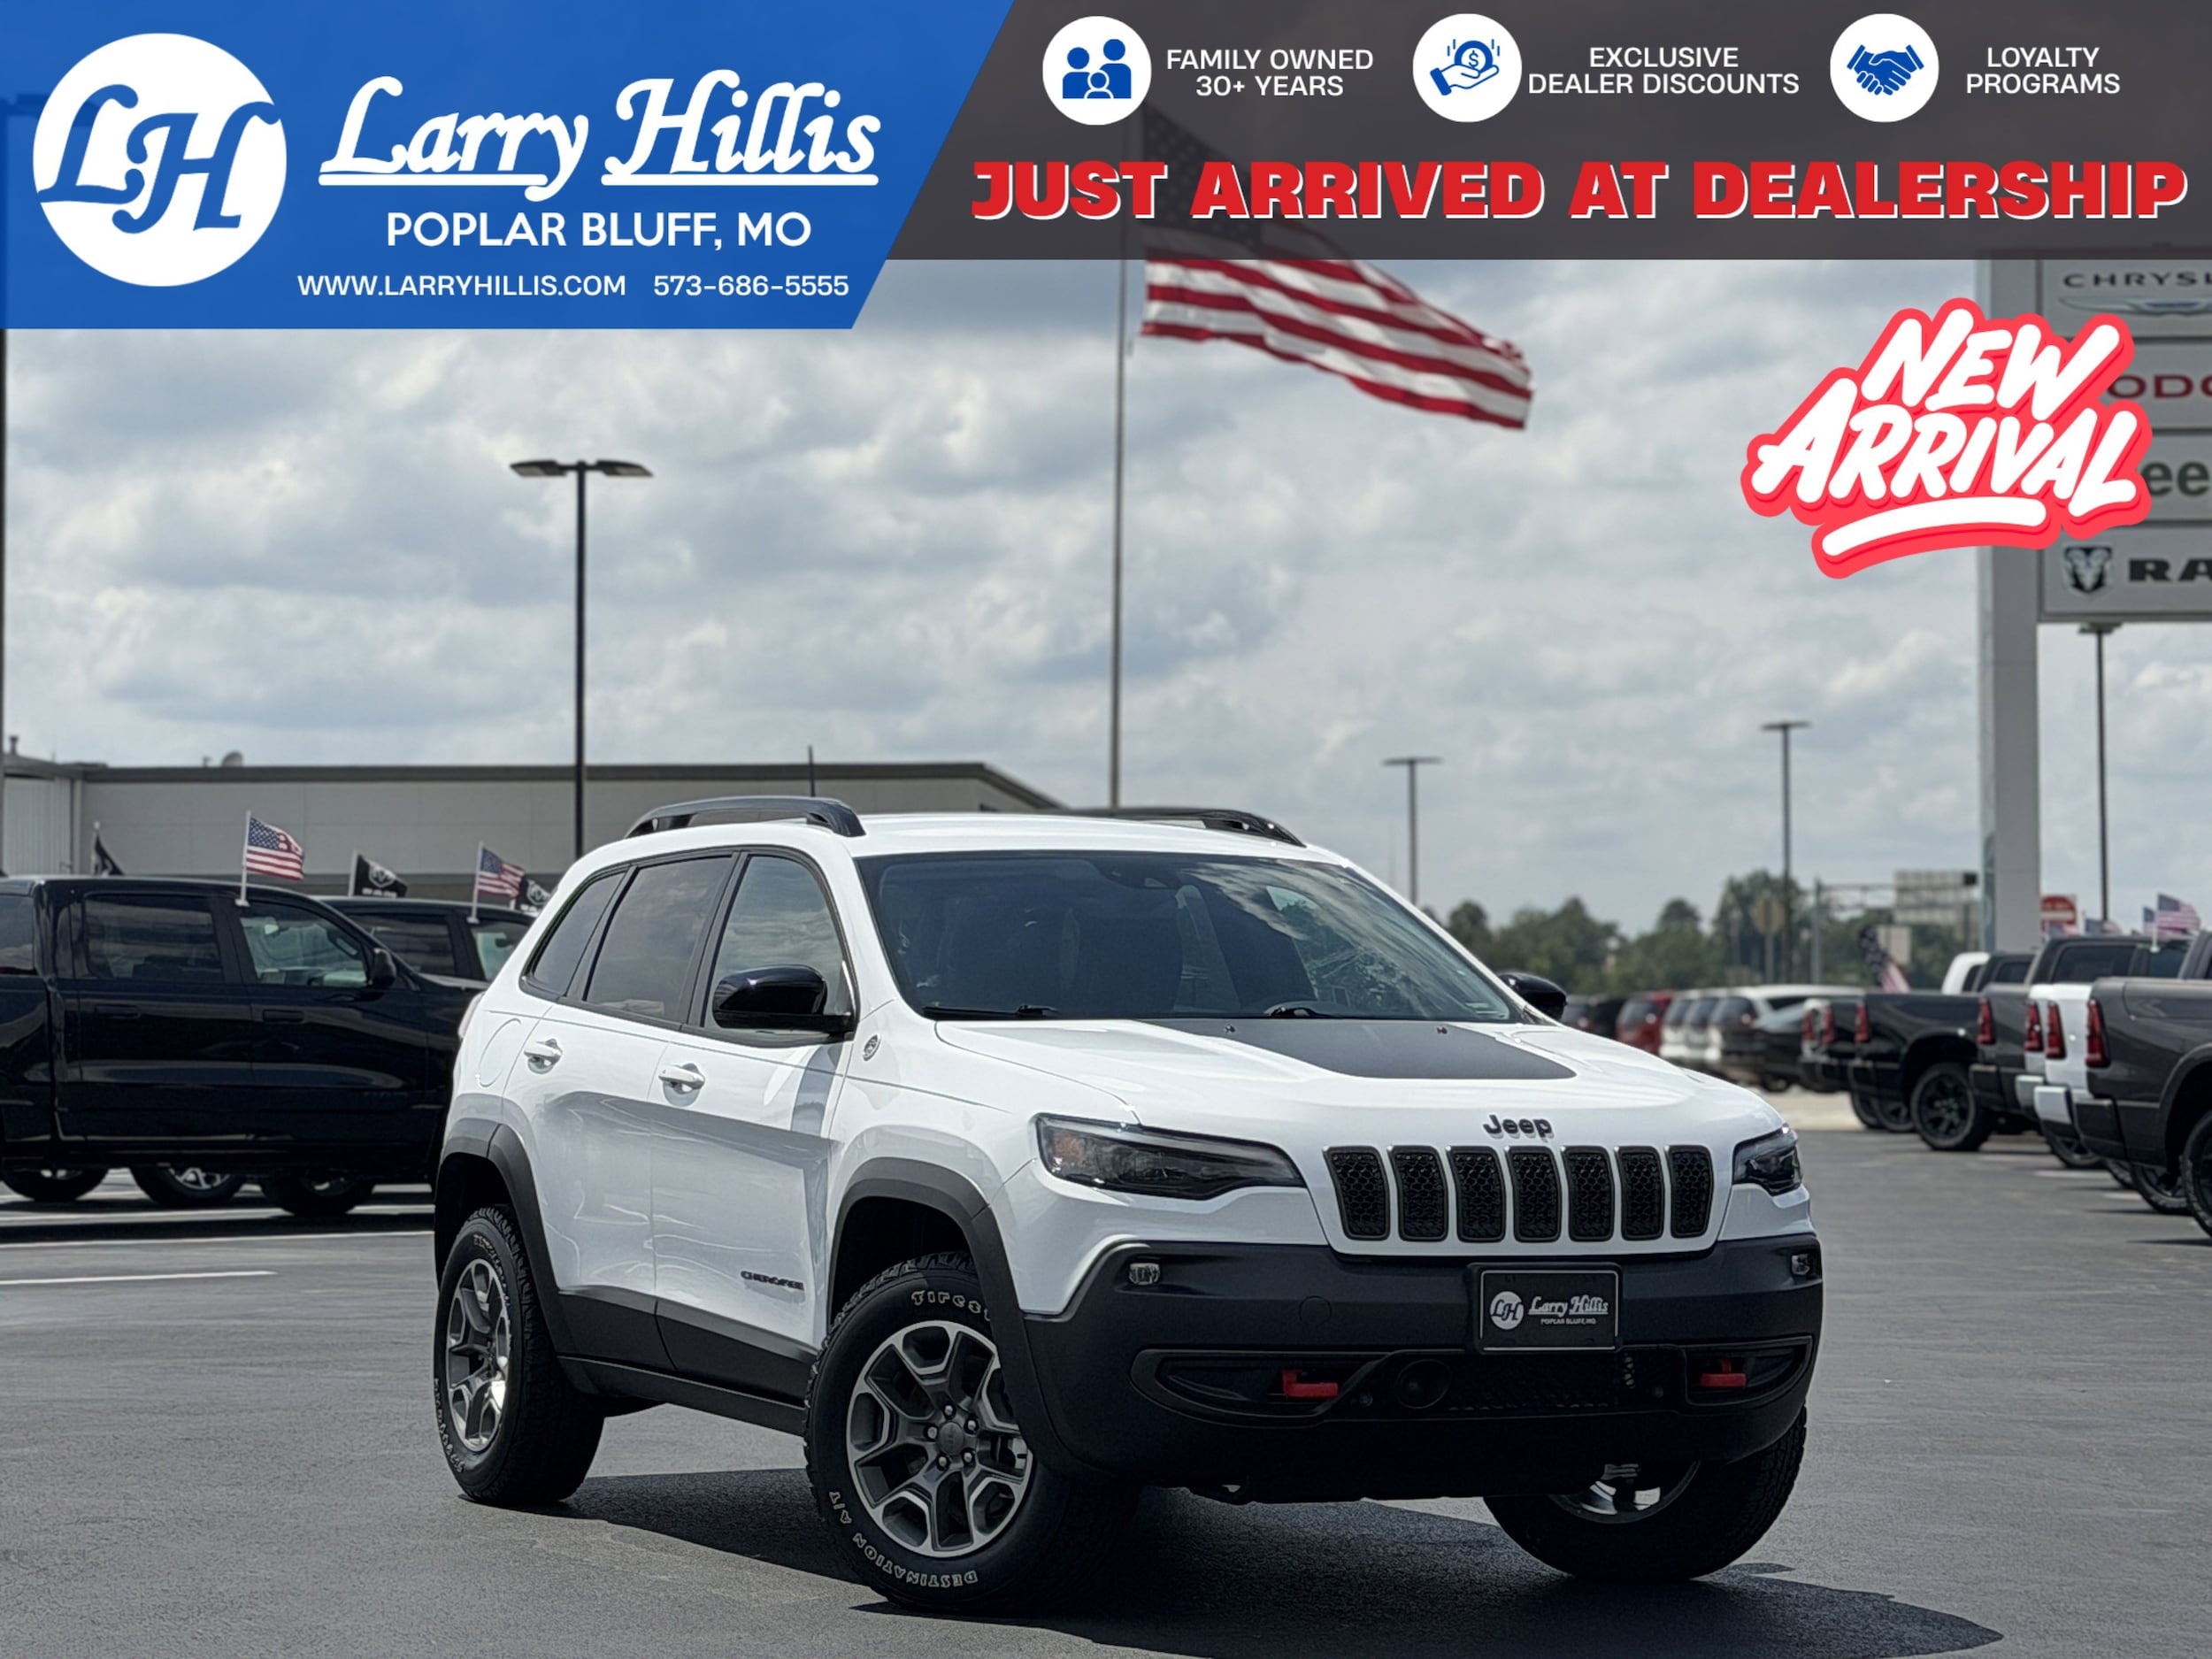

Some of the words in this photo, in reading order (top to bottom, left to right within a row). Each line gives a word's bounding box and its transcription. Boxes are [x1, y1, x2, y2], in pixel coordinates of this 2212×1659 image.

[1482, 1114, 1555, 1140] Jeep
[1528, 1295, 1568, 1317] Larry
[1570, 1294, 1609, 1316] Hillis
[852, 1532, 979, 1588] DESTINATION
